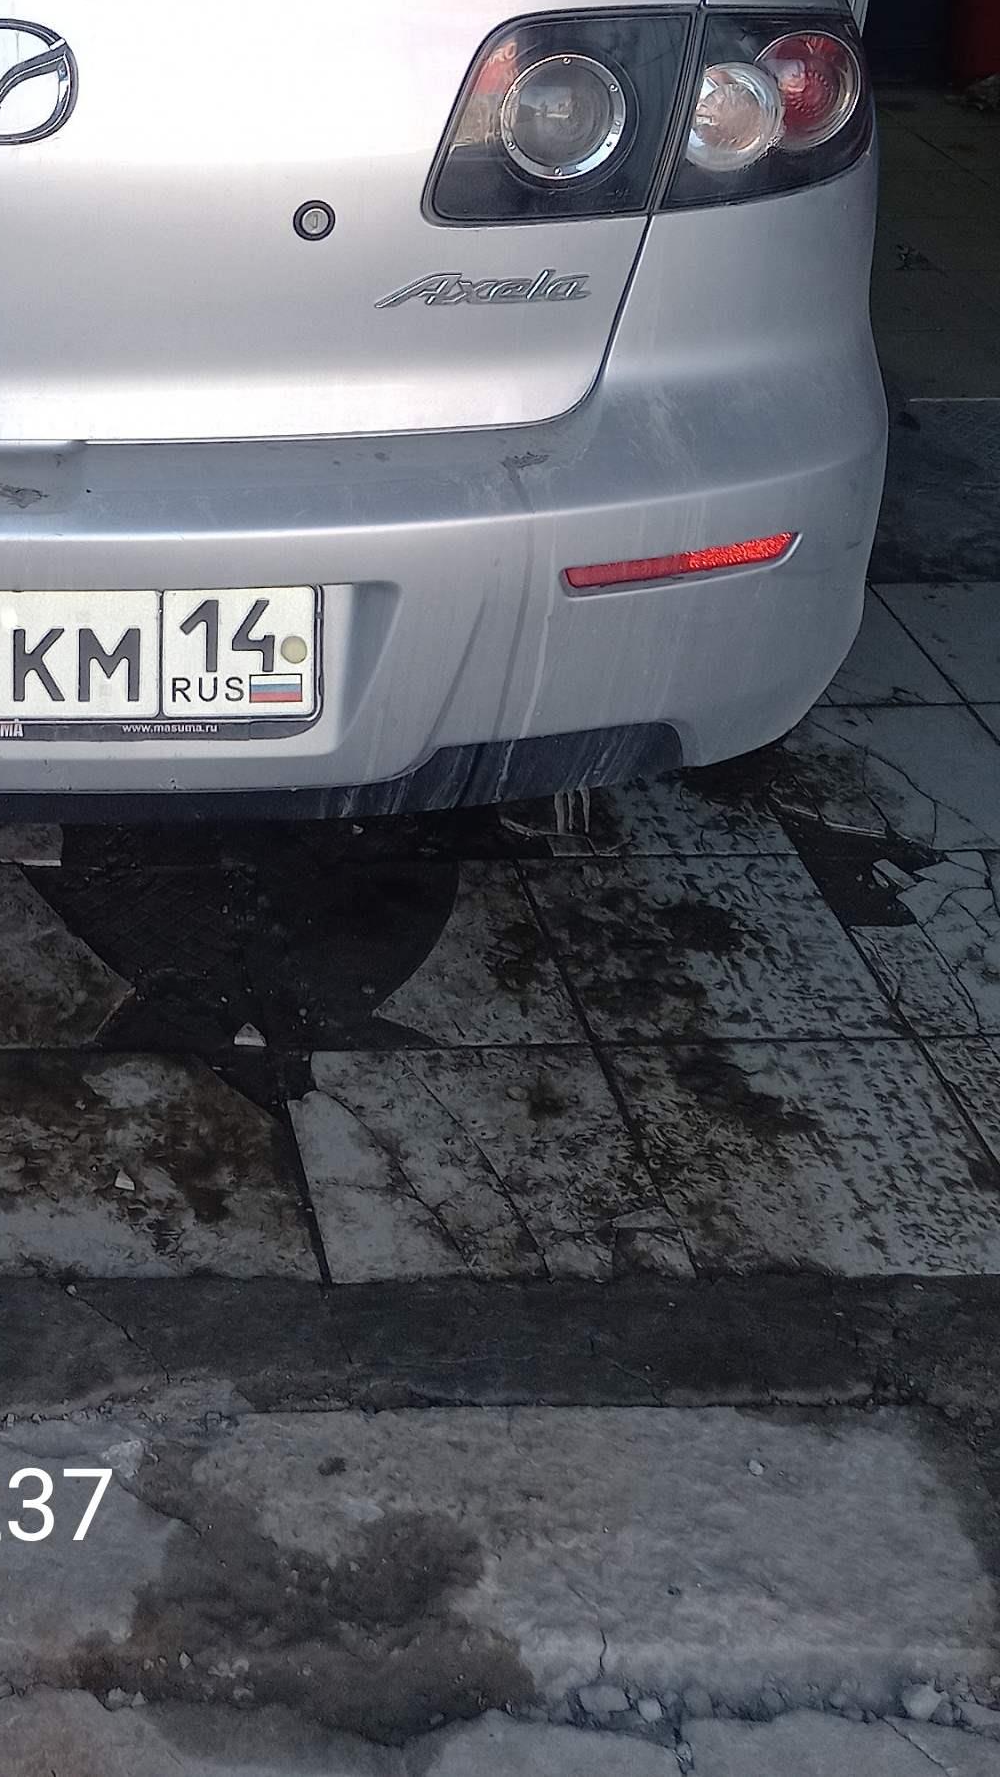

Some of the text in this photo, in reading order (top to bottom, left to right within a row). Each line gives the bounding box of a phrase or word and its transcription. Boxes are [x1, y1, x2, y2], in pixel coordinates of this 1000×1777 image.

[374, 269, 592, 308] Axela
[179, 599, 275, 673] 14
[171, 676, 244, 703] RUS
[122, 723, 218, 734] www.masuma.ru
